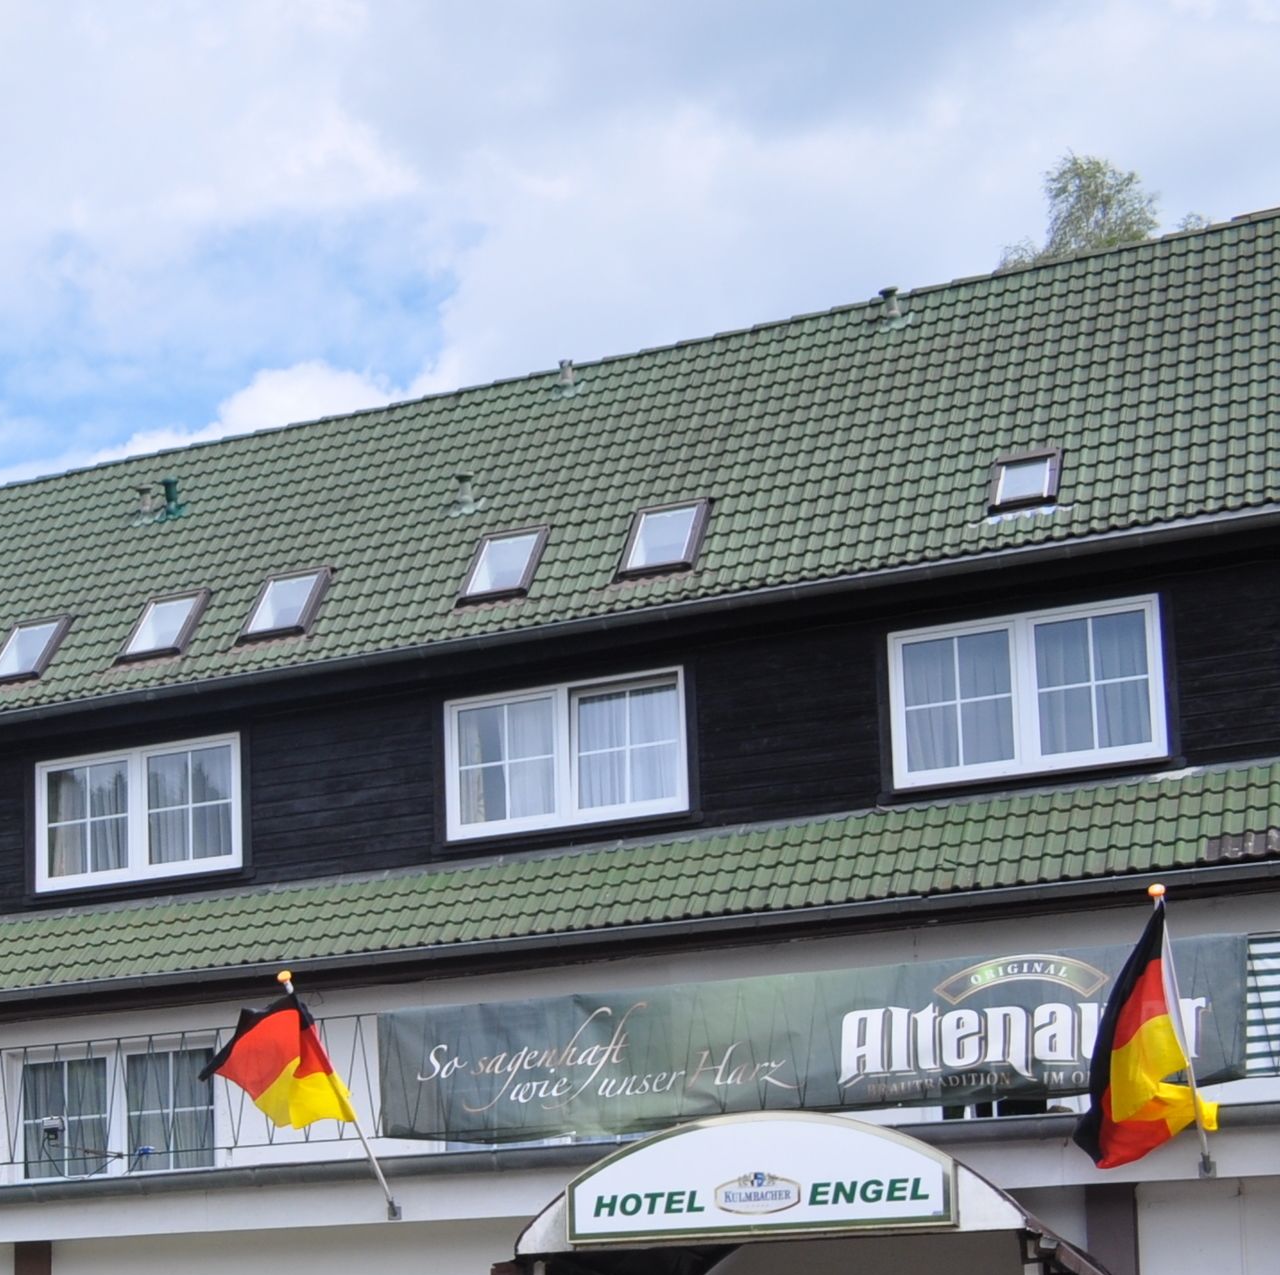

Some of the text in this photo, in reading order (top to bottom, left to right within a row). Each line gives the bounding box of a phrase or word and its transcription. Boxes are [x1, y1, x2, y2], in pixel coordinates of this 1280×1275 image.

[970, 962, 1069, 986] ORIGINAL
[417, 1002, 647, 1113] So sagenhaft
[839, 996, 1209, 1086] Altenar
[510, 1041, 802, 1104] wie unser Harz
[867, 1071, 1011, 1096] BRAUTRADITION
[1043, 1070, 1065, 1086] IM
[593, 1177, 930, 1218] HOTEL ENGEL
[724, 1189, 791, 1203] KULMBACHER
